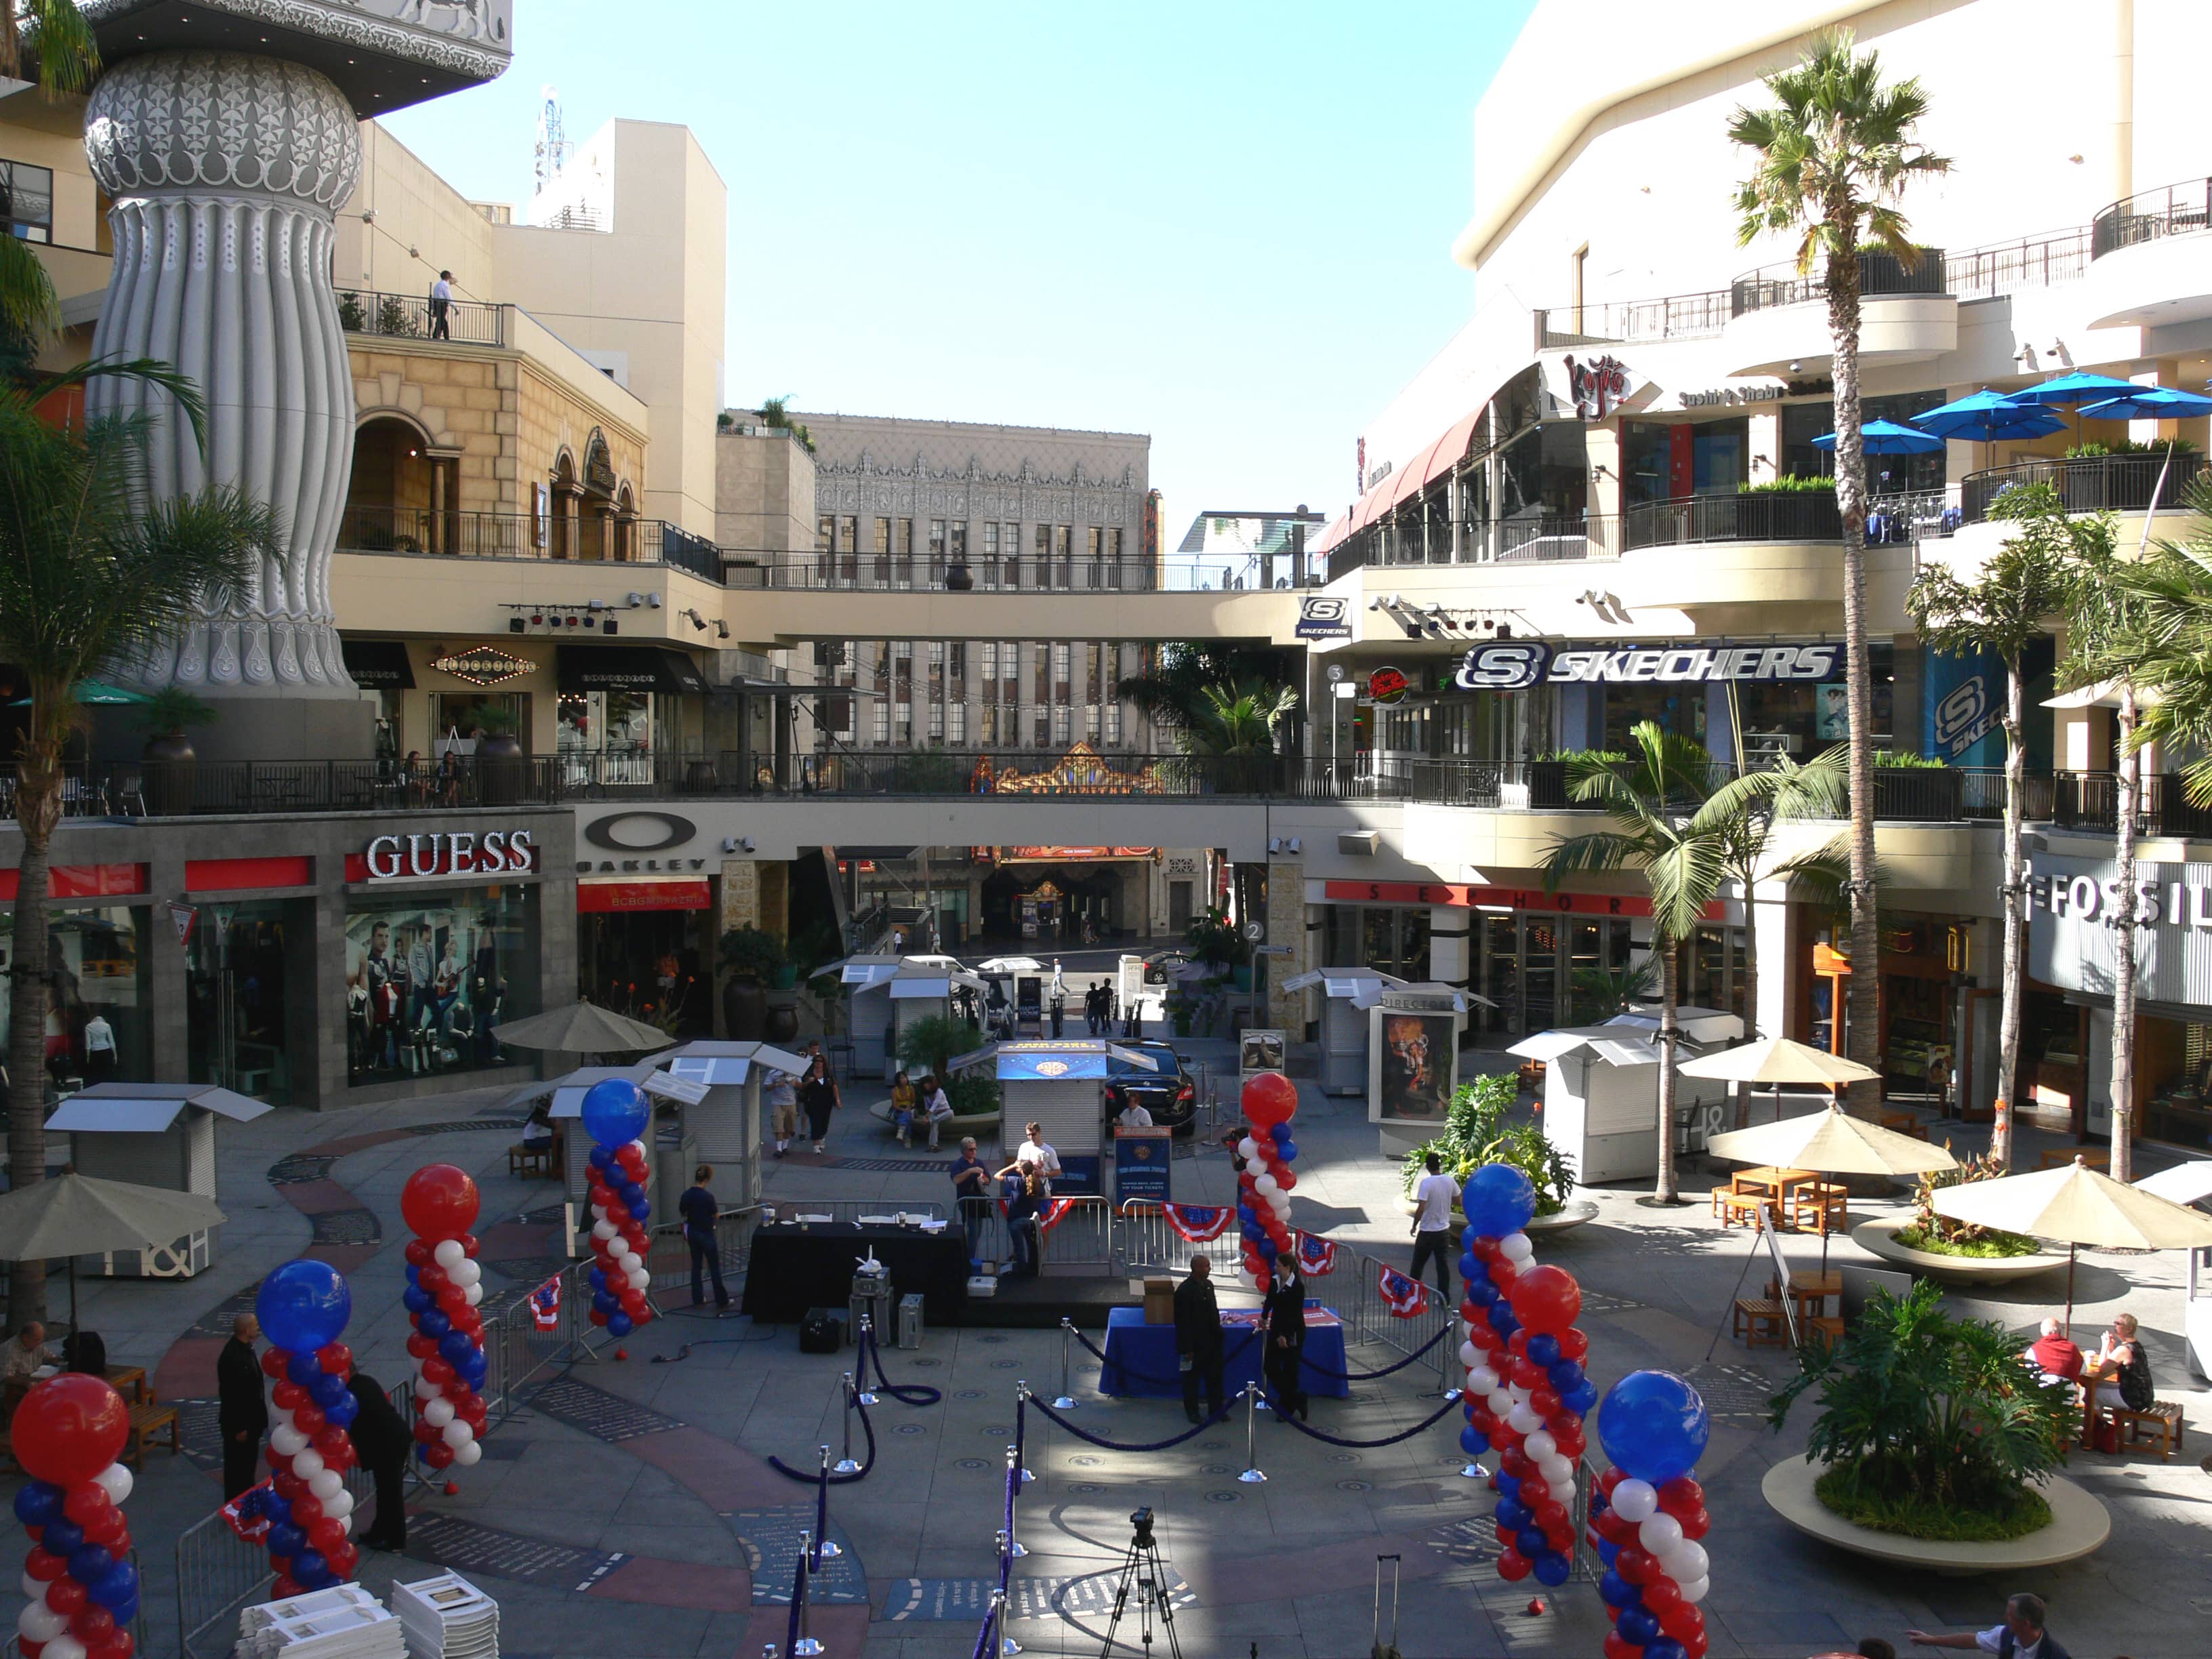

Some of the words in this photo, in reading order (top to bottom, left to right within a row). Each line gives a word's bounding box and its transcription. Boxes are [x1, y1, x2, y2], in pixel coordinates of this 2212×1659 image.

[1679, 391, 1719, 407] Sushi
[436, 659, 537, 673] BLACKJACK
[1547, 646, 1837, 682] SKECHERS
[1331, 667, 1340, 680] 3
[367, 830, 532, 878] GUESS
[576, 859, 705, 873] OAKLEY
[1370, 884, 1621, 915] SEPHOR
[2051, 875, 2212, 926] FOSSIL
[1248, 924, 1259, 939] 2
[1381, 998, 1456, 1008] DIRECTORY
